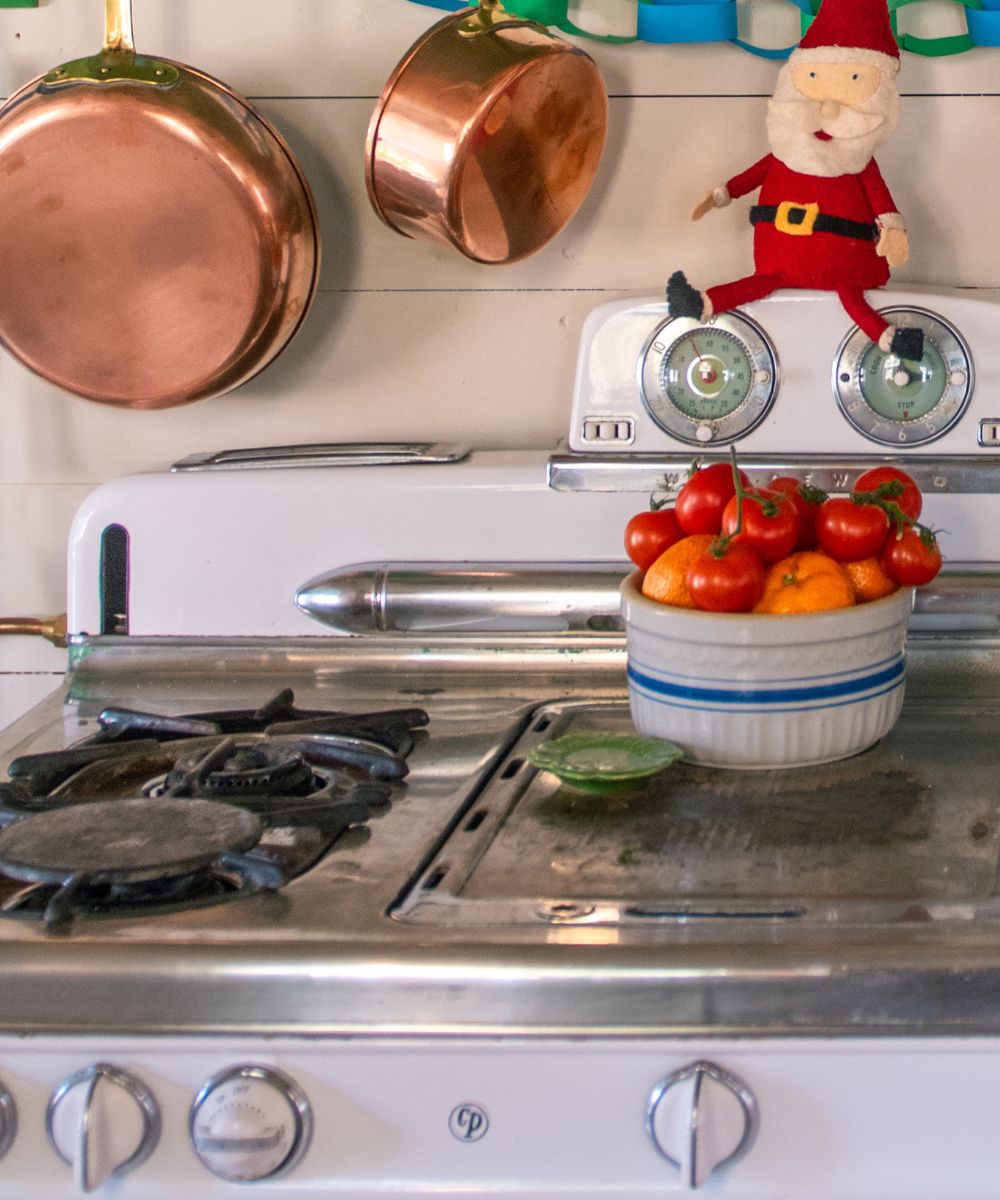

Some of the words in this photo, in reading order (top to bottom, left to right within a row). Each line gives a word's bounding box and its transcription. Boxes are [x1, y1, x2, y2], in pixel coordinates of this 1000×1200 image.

[651, 341, 666, 355] 10
[870, 355, 883, 375] COOK
[898, 401, 915, 409] STOP
[898, 428, 906, 441] 6
[926, 423, 936, 433] 5
